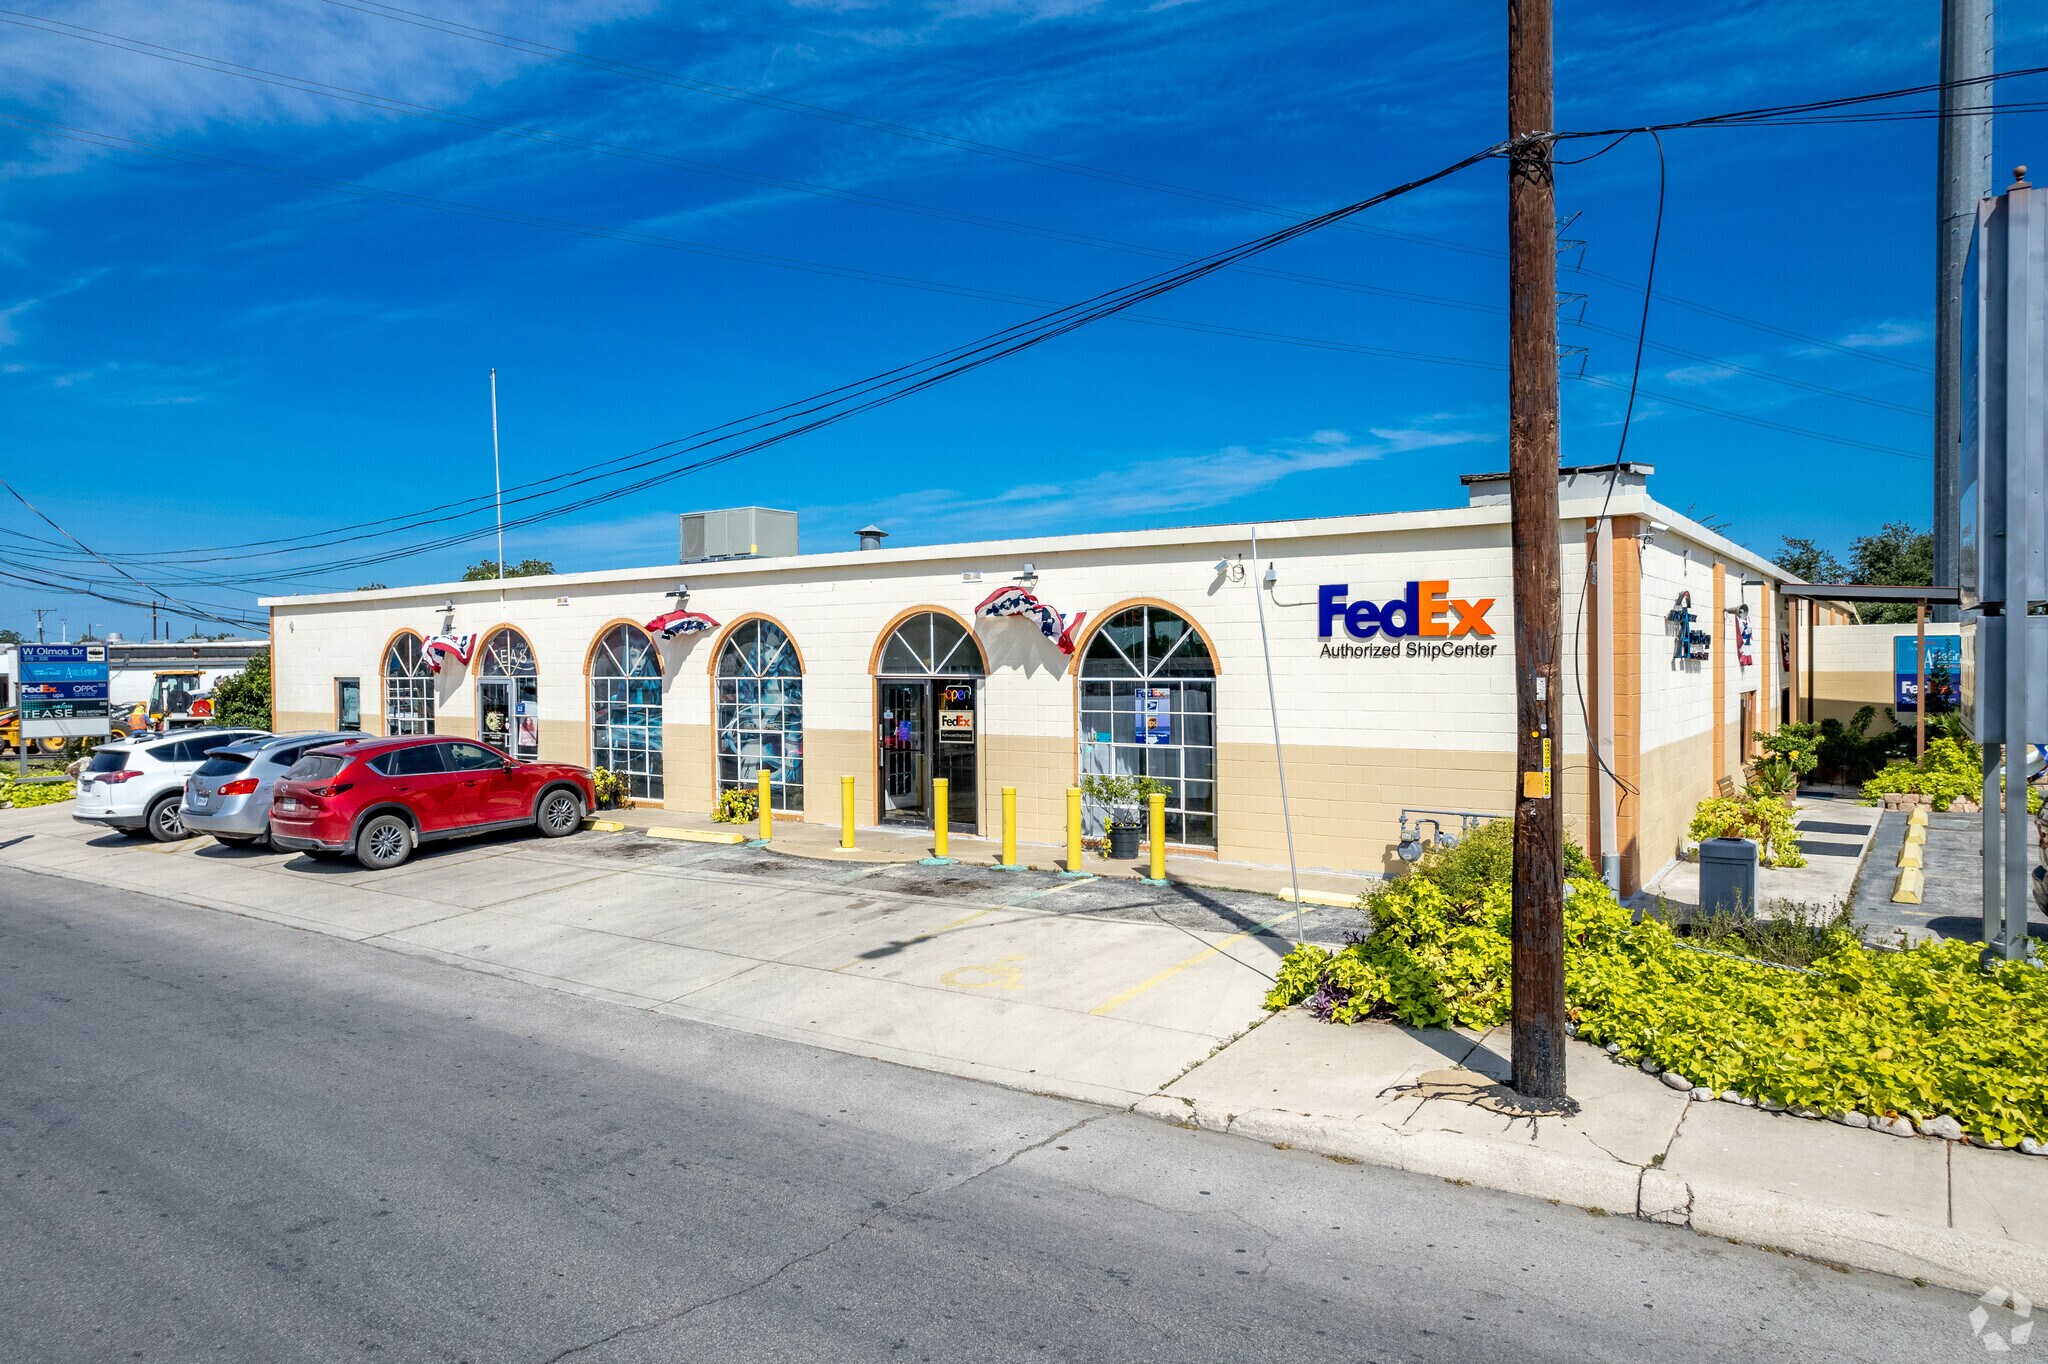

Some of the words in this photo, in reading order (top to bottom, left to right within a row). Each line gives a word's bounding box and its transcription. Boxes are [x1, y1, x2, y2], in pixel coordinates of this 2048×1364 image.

[1319, 580, 1496, 638] FedEx
[22, 647, 34, 655] W
[36, 647, 69, 655] Olmos
[71, 647, 84, 655] Dr
[1320, 643, 1400, 657] Authorized
[1406, 642, 1497, 661] ShipCenter
[22, 684, 56, 692] FedEx
[945, 690, 970, 702] open
[22, 708, 73, 718] TEASE
[942, 715, 970, 726] FedEx
